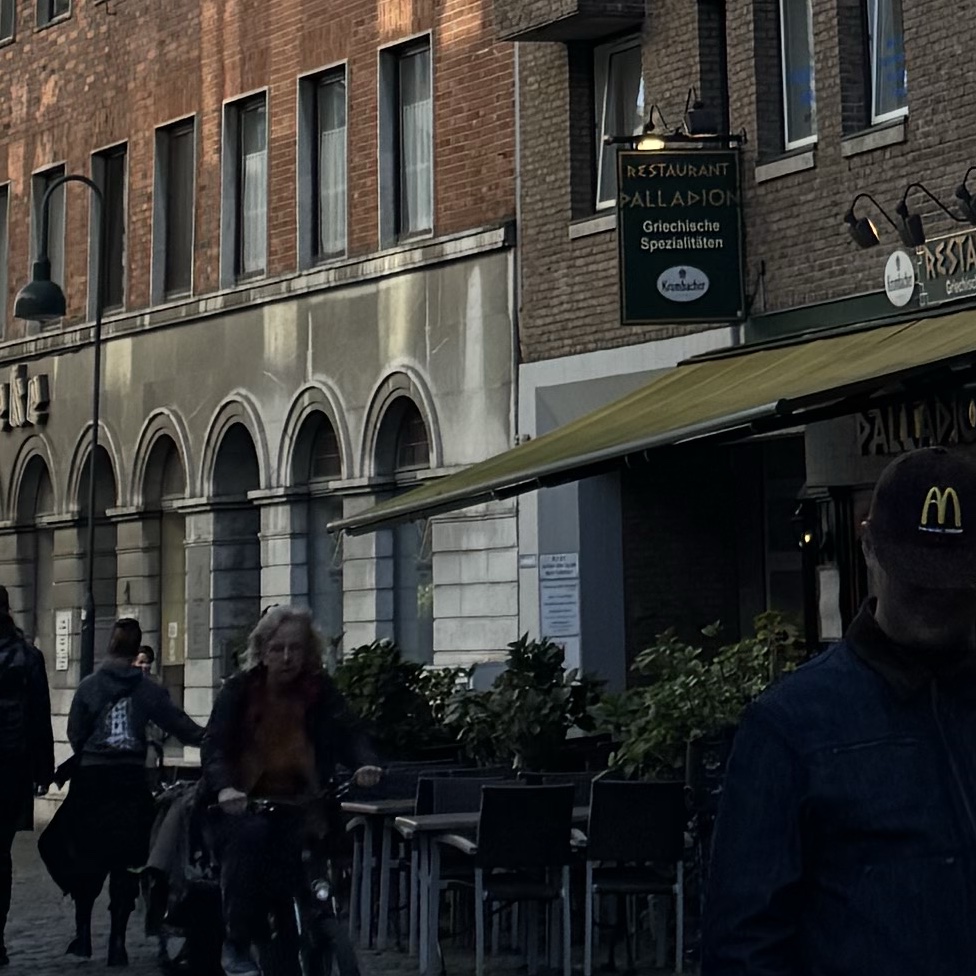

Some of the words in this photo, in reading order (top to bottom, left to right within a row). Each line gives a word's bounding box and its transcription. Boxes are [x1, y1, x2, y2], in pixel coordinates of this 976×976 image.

[626, 161, 731, 178] RESTAURANT
[619, 187, 741, 209] PALLADION
[642, 218, 721, 234] Griechische
[640, 235, 724, 253] Spezialitäten
